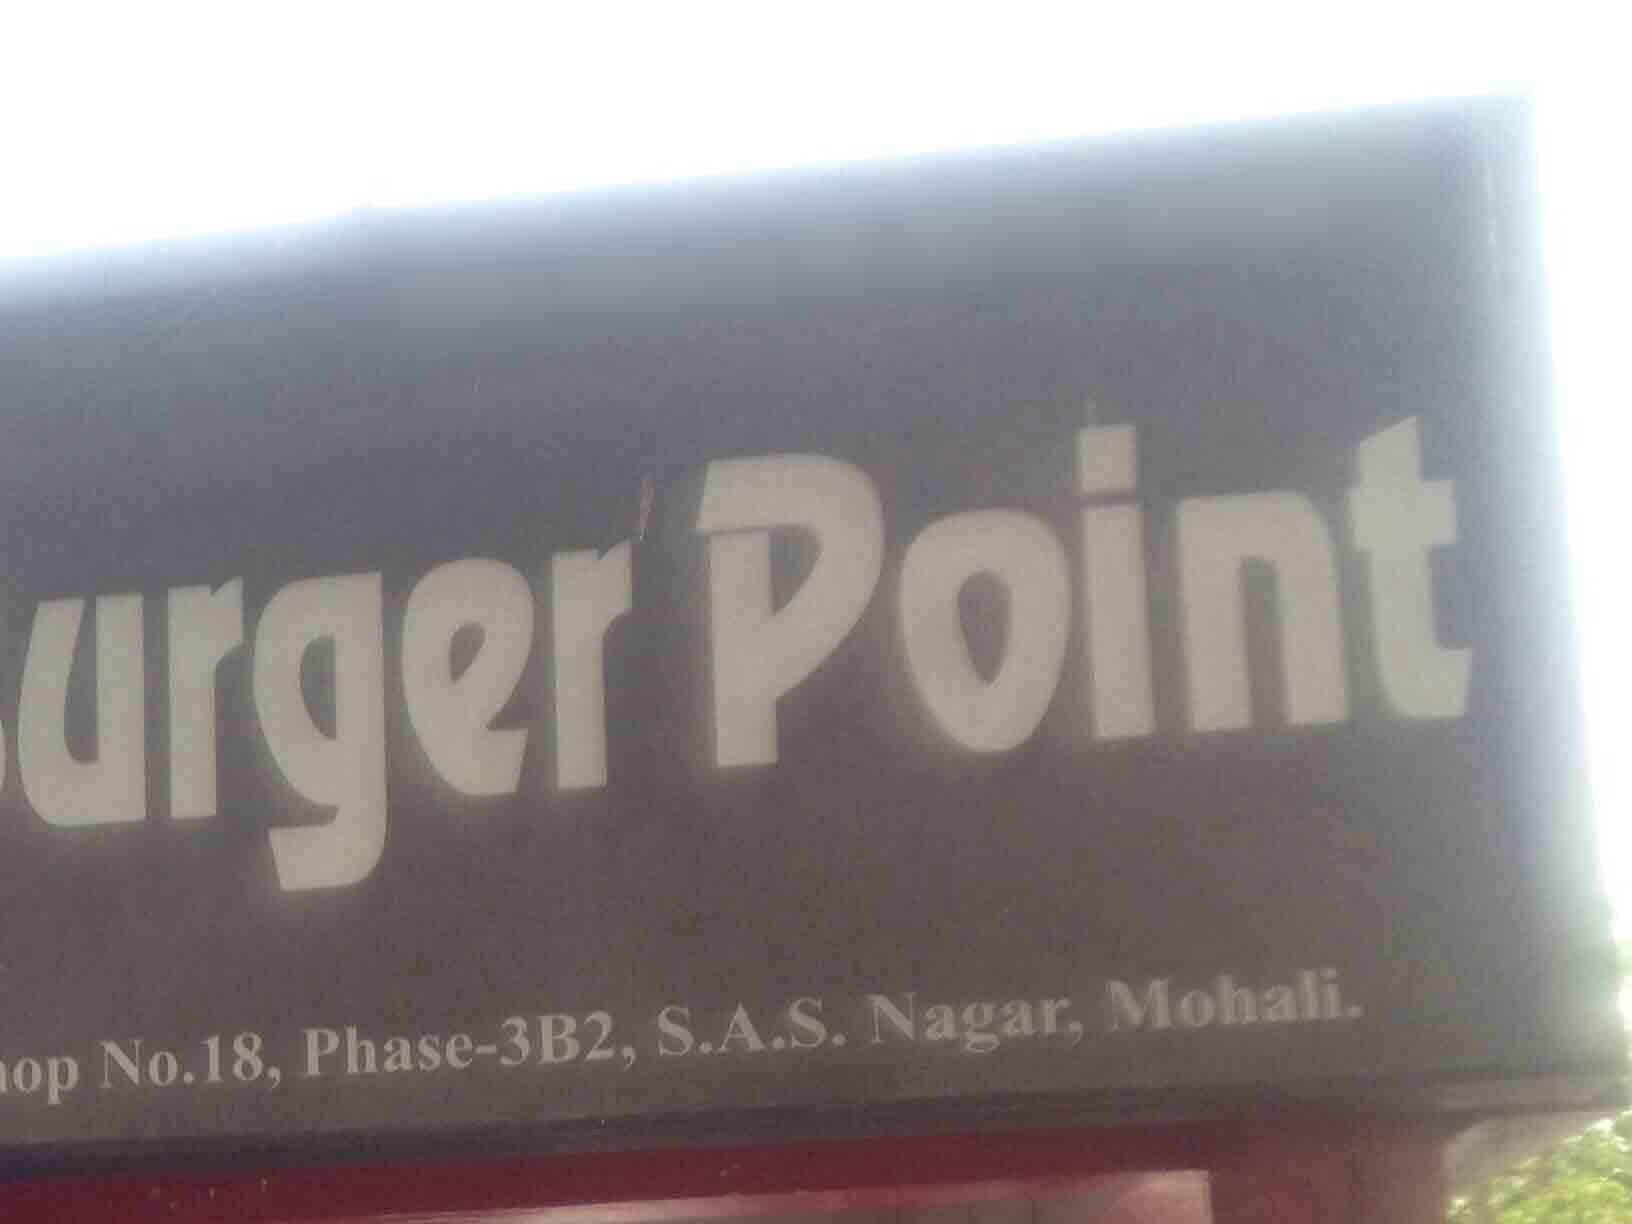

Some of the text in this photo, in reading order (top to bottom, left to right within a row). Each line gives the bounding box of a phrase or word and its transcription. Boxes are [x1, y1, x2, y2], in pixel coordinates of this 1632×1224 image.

[697, 416, 1474, 768] Point
[99, 1030, 282, 1090] No.18,
[303, 1009, 636, 1077] Phase-3B2,
[657, 997, 847, 1056] S.A.S.
[868, 991, 1084, 1055] Nagar,
[1105, 967, 1363, 1034] Mohali.
